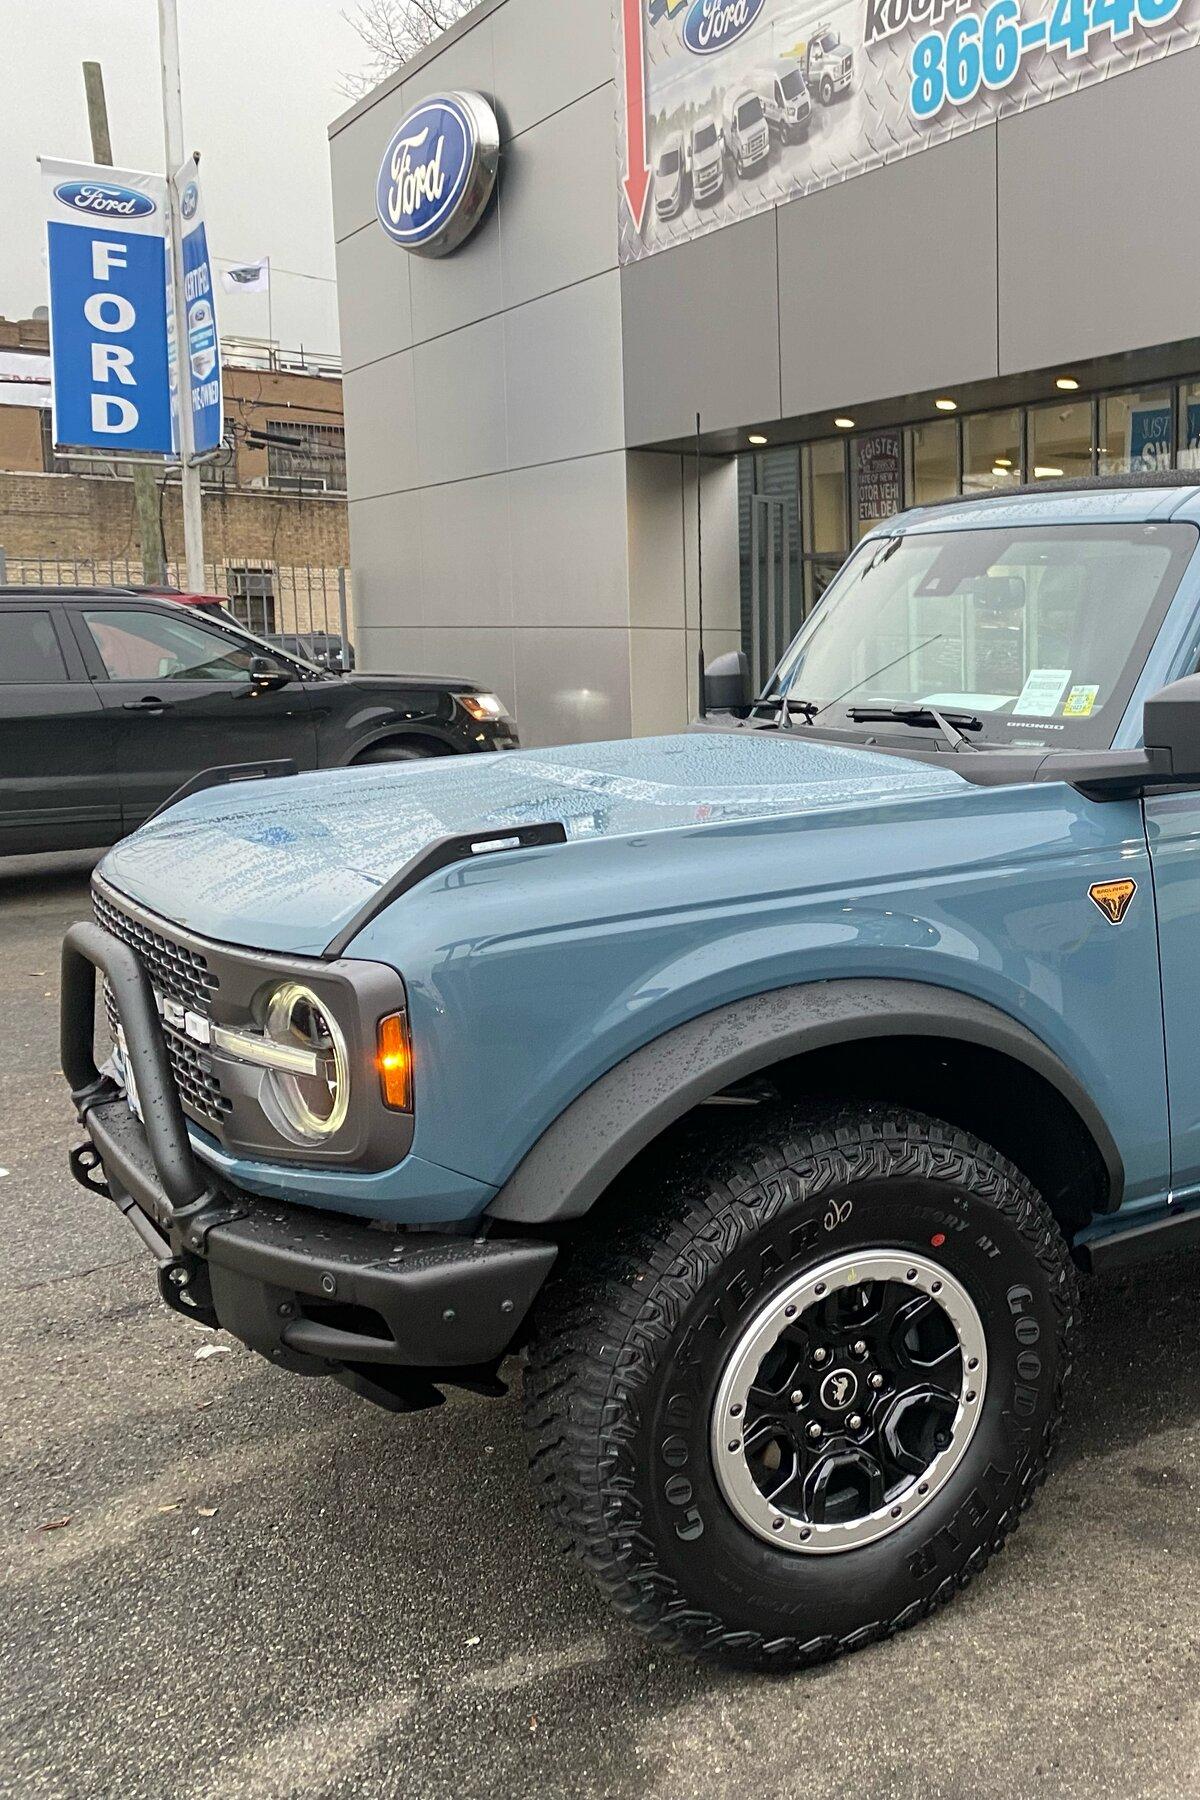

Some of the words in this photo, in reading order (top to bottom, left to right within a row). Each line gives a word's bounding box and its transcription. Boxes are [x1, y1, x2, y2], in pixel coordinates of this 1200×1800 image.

[910, 0, 1180, 118] 866-44
[74, 185, 135, 215] Ford
[388, 127, 445, 224] Ford
[83, 240, 139, 434] FORD
